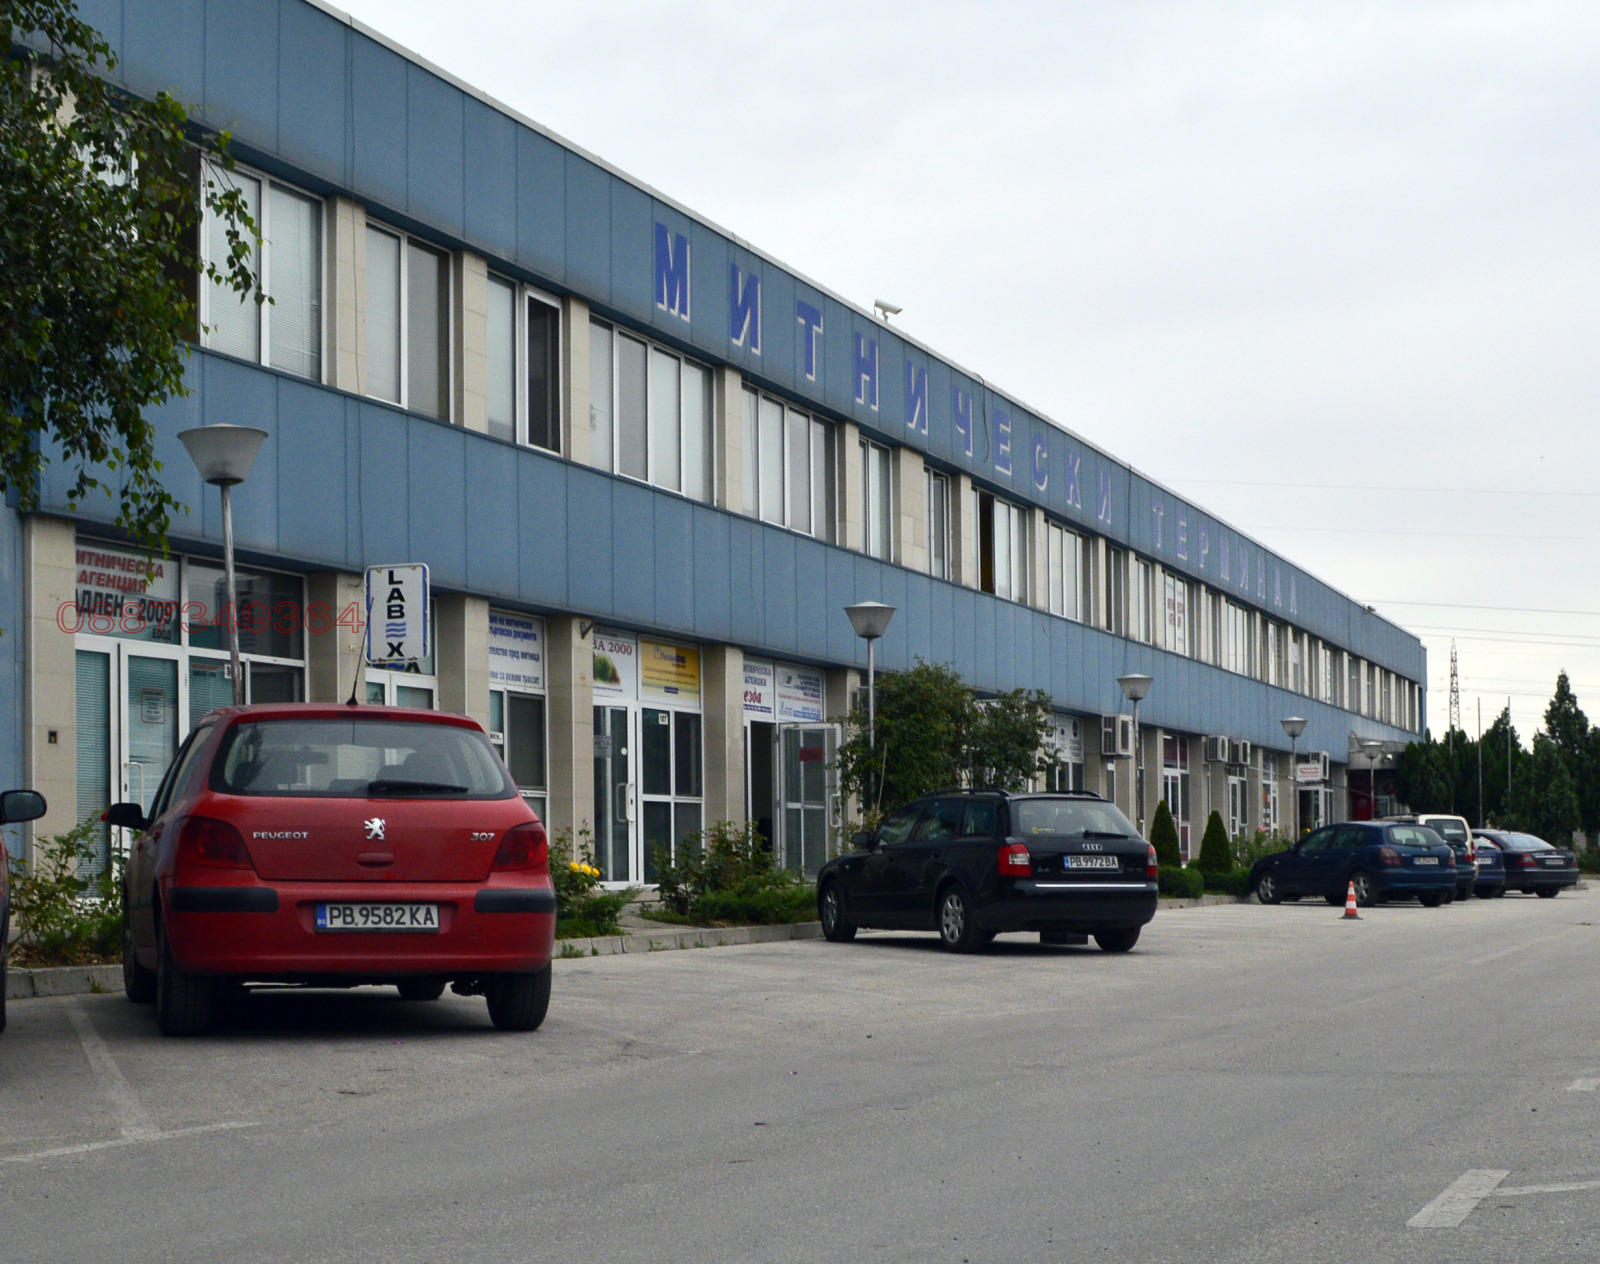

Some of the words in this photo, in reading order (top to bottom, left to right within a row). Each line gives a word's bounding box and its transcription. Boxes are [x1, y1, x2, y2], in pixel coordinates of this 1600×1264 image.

[654, 221, 1112, 525] МИТНИЧЕСКИ
[1151, 499, 1298, 615] ТЕРМИНАЛ
[78, 569, 149, 593] АГЕНЦИЯ
[608, 641, 632, 656] 2000
[253, 831, 309, 840] PEUGEOT
[470, 832, 495, 842] 307
